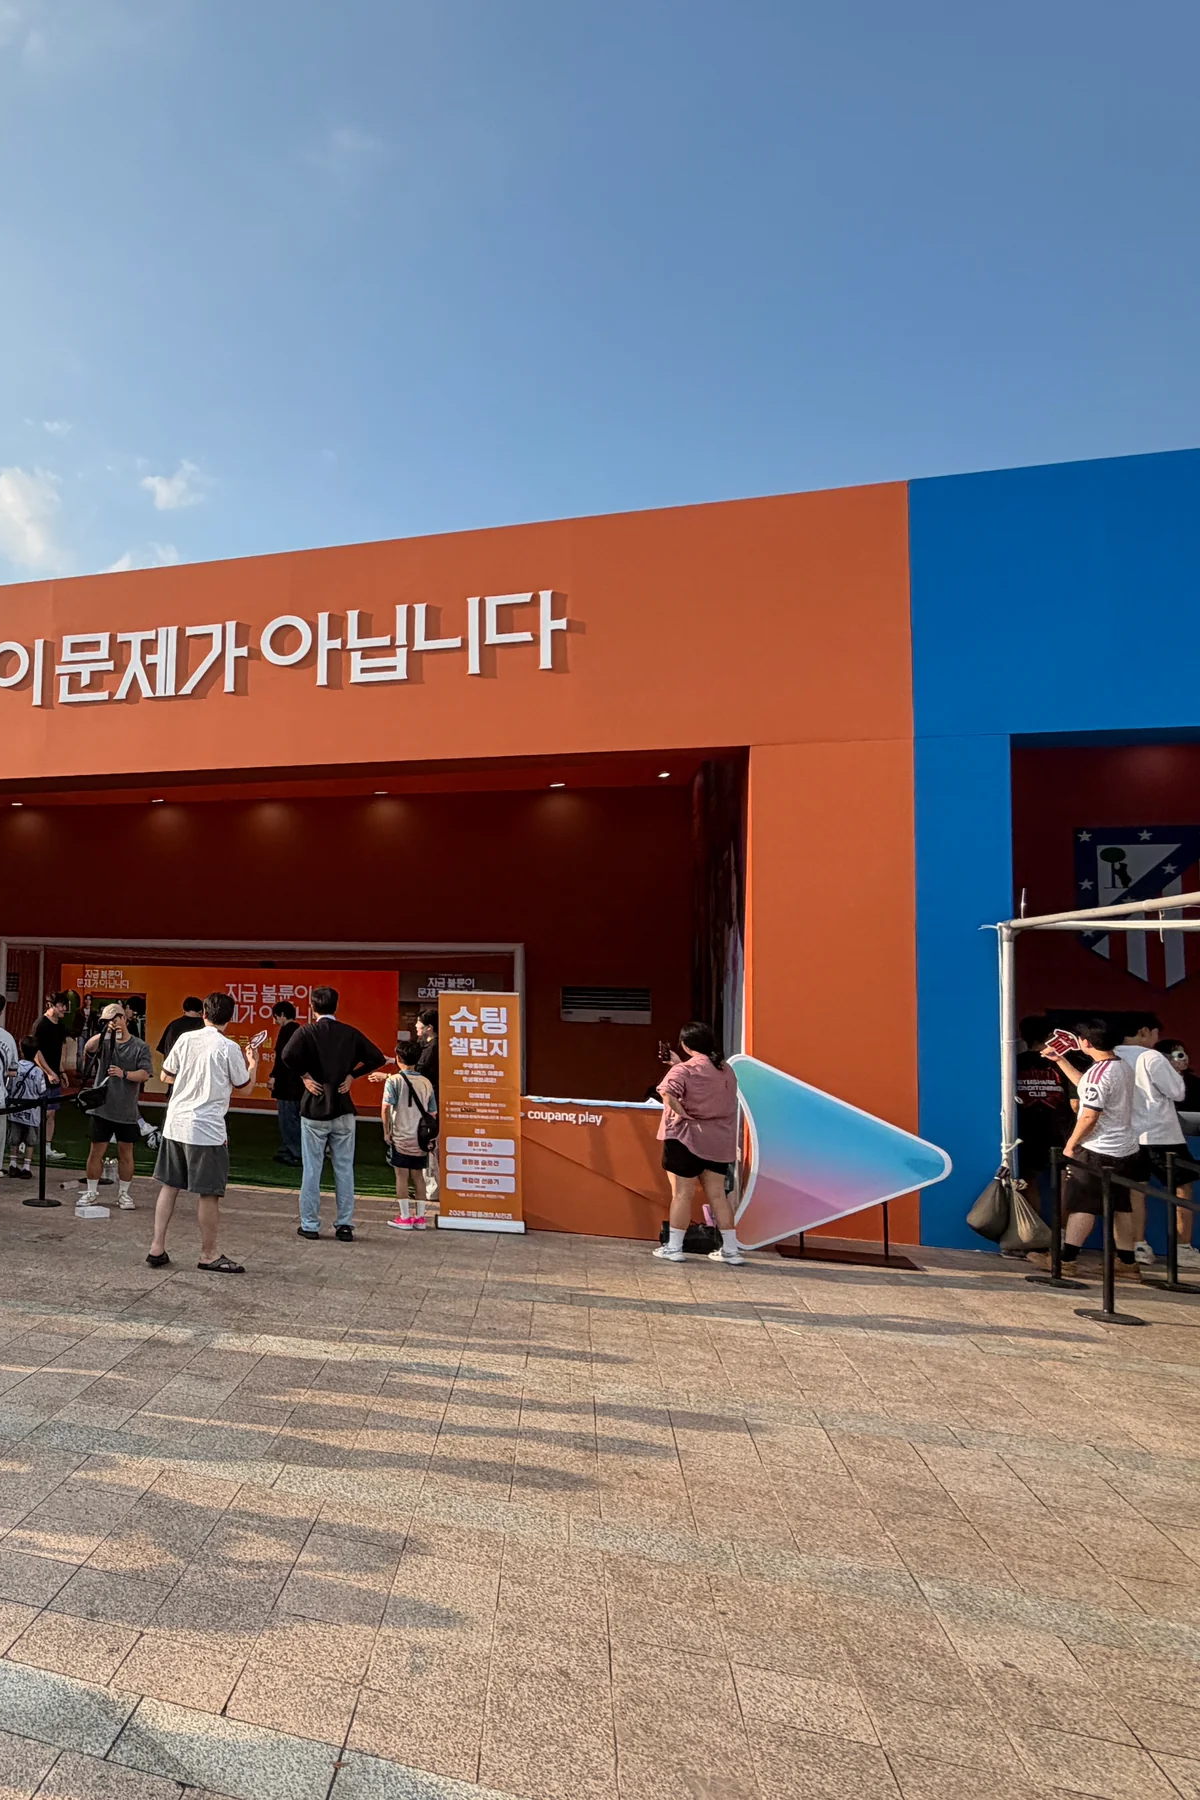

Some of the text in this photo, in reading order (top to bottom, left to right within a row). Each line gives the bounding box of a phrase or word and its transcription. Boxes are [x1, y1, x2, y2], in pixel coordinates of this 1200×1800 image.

[55, 620, 248, 703] 문제가
[260, 589, 568, 687] 아닙니다
[84, 969, 100, 979] 지금
[225, 983, 313, 1004] 지금 불륜이
[448, 1006, 508, 1034] 슈팅
[448, 1036, 508, 1058] 챌린지
[527, 1110, 577, 1124] coupang
[578, 1111, 603, 1126] play
